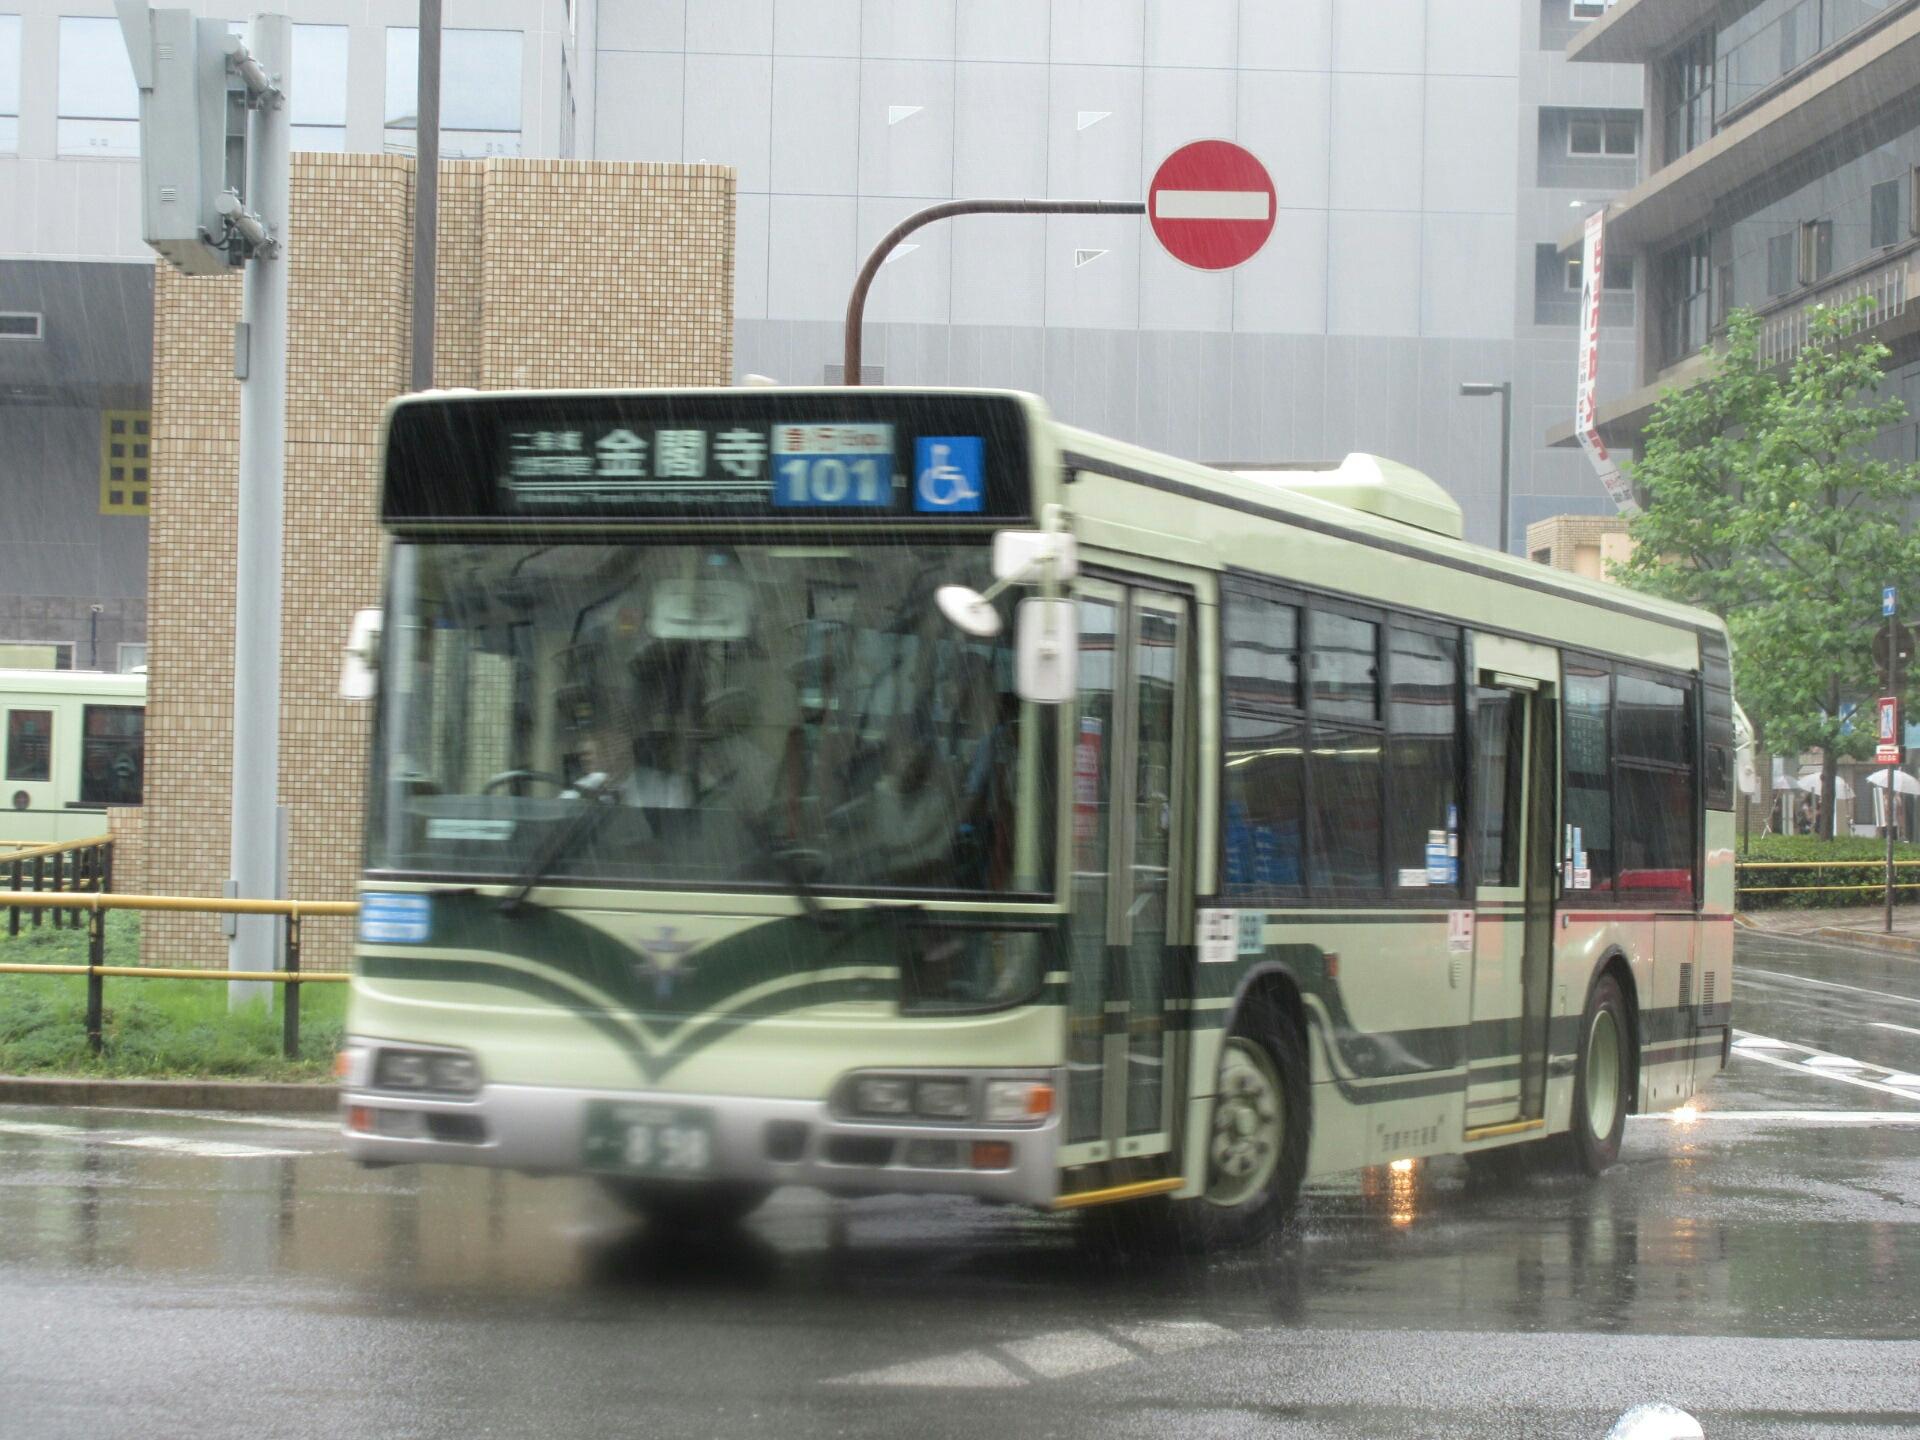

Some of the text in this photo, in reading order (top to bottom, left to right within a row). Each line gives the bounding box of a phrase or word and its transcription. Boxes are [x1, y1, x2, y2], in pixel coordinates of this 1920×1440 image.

[594, 428, 768, 478] 金閣寺
[779, 458, 878, 502] 101
